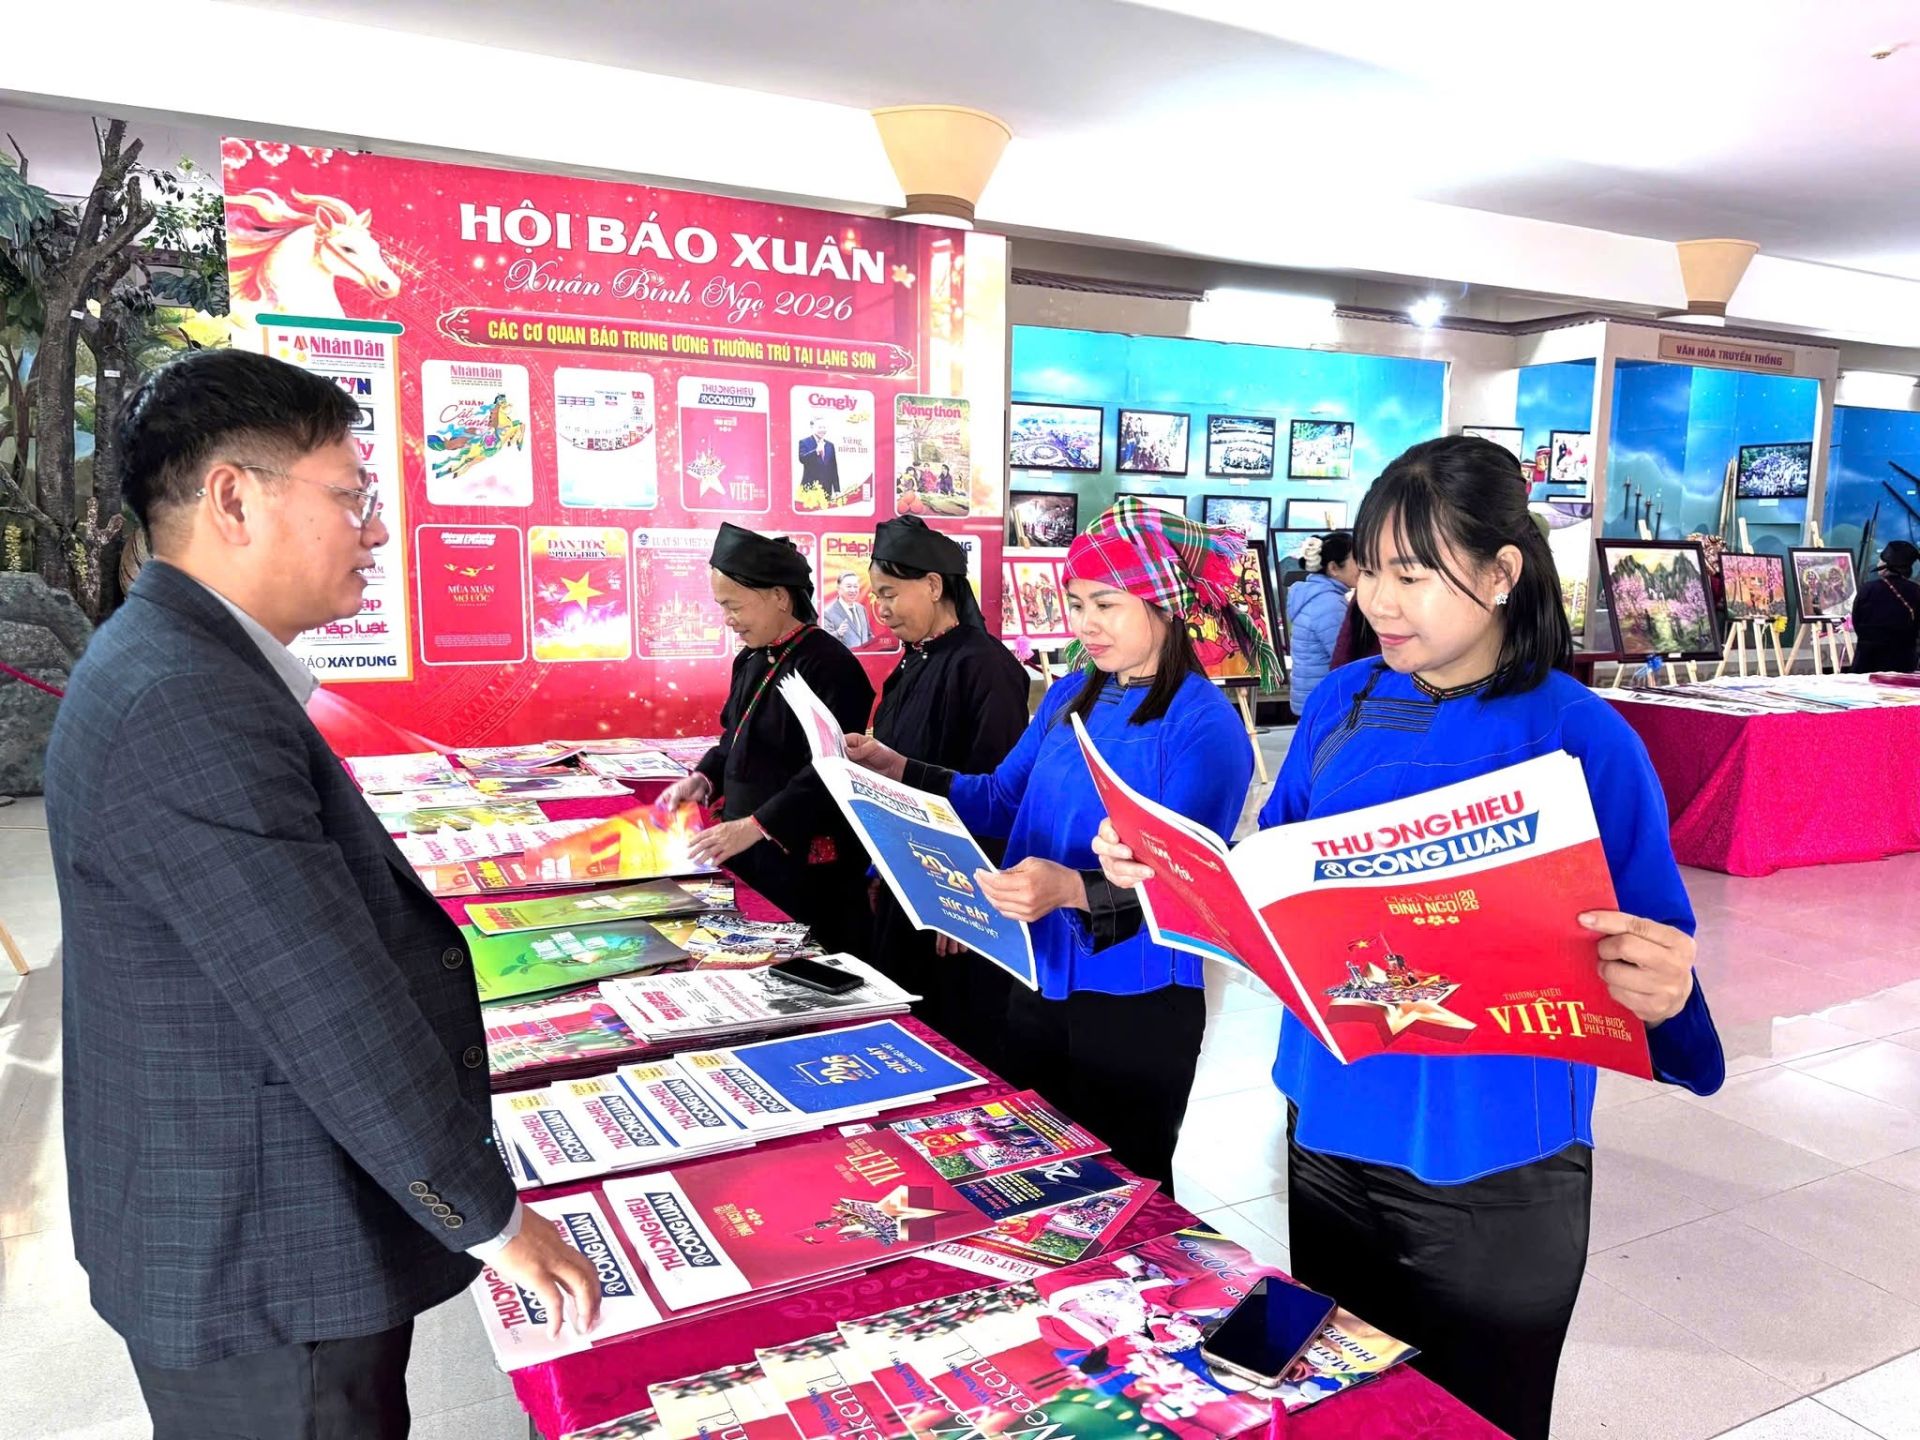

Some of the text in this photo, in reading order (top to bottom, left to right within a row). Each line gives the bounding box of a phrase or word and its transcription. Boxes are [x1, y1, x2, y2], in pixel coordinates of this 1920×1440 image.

[459, 199, 885, 285] HỘI BÁO XUÂN
[504, 256, 604, 296] Xuân
[701, 275, 765, 324] Ngọ
[774, 290, 854, 321] 2026
[487, 318, 876, 370] CÁC CƠ QUAN BÁO TRUNG ƯƠNG THƯỜNG TRÚ TẠI LẠNG SƠN
[1675, 344, 1695, 355] VĂN
[1485, 997, 1588, 1040] VIỆT
[1177, 1239, 1249, 1281] 2026
[1309, 1344, 1358, 1373] Merr
